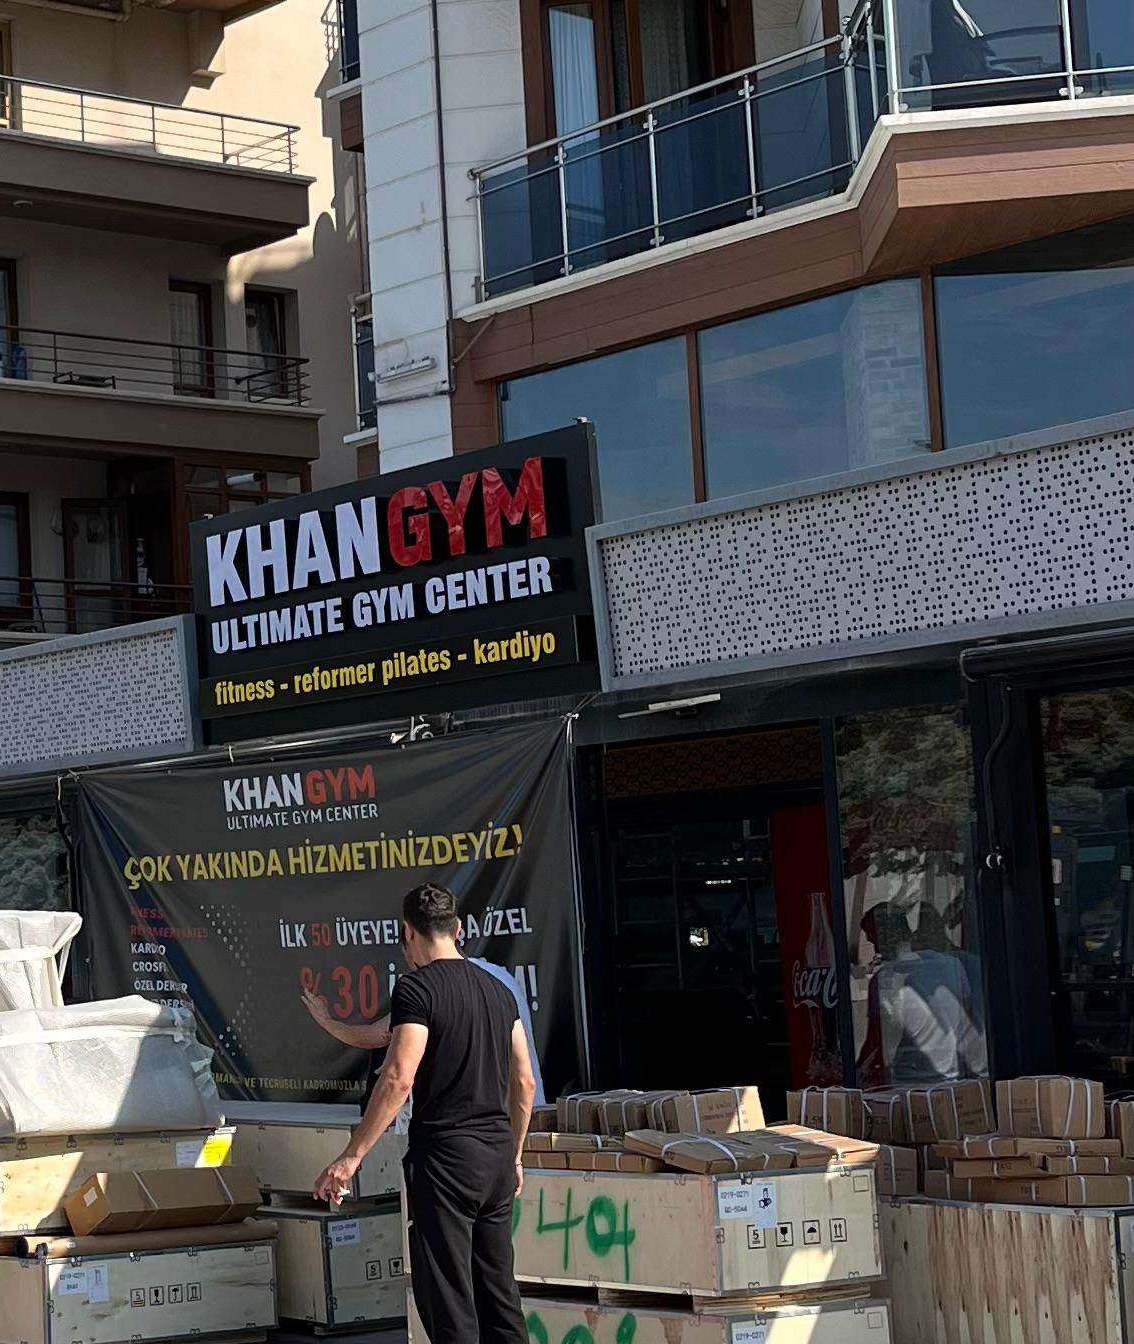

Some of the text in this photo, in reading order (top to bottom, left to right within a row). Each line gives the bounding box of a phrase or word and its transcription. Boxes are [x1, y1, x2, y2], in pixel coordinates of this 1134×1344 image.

[205, 456, 547, 607] KHAN GYM
[211, 556, 553, 655] ULTIMATE GYM CENTER
[214, 676, 275, 706] fitness
[294, 661, 376, 694] reformer
[381, 648, 452, 685] pilates
[474, 629, 556, 666] kardiyo
[227, 803, 379, 831] ULTIMATE GYM CENTER
[123, 821, 523, 890] ÇOK YAKINDA HİZMETİNİZDEYİZ!
[279, 918, 308, 948] İLK
[311, 922, 331, 947] 50
[335, 917, 400, 946] ÜYEYE!
[483, 906, 533, 937] ÖZEL
